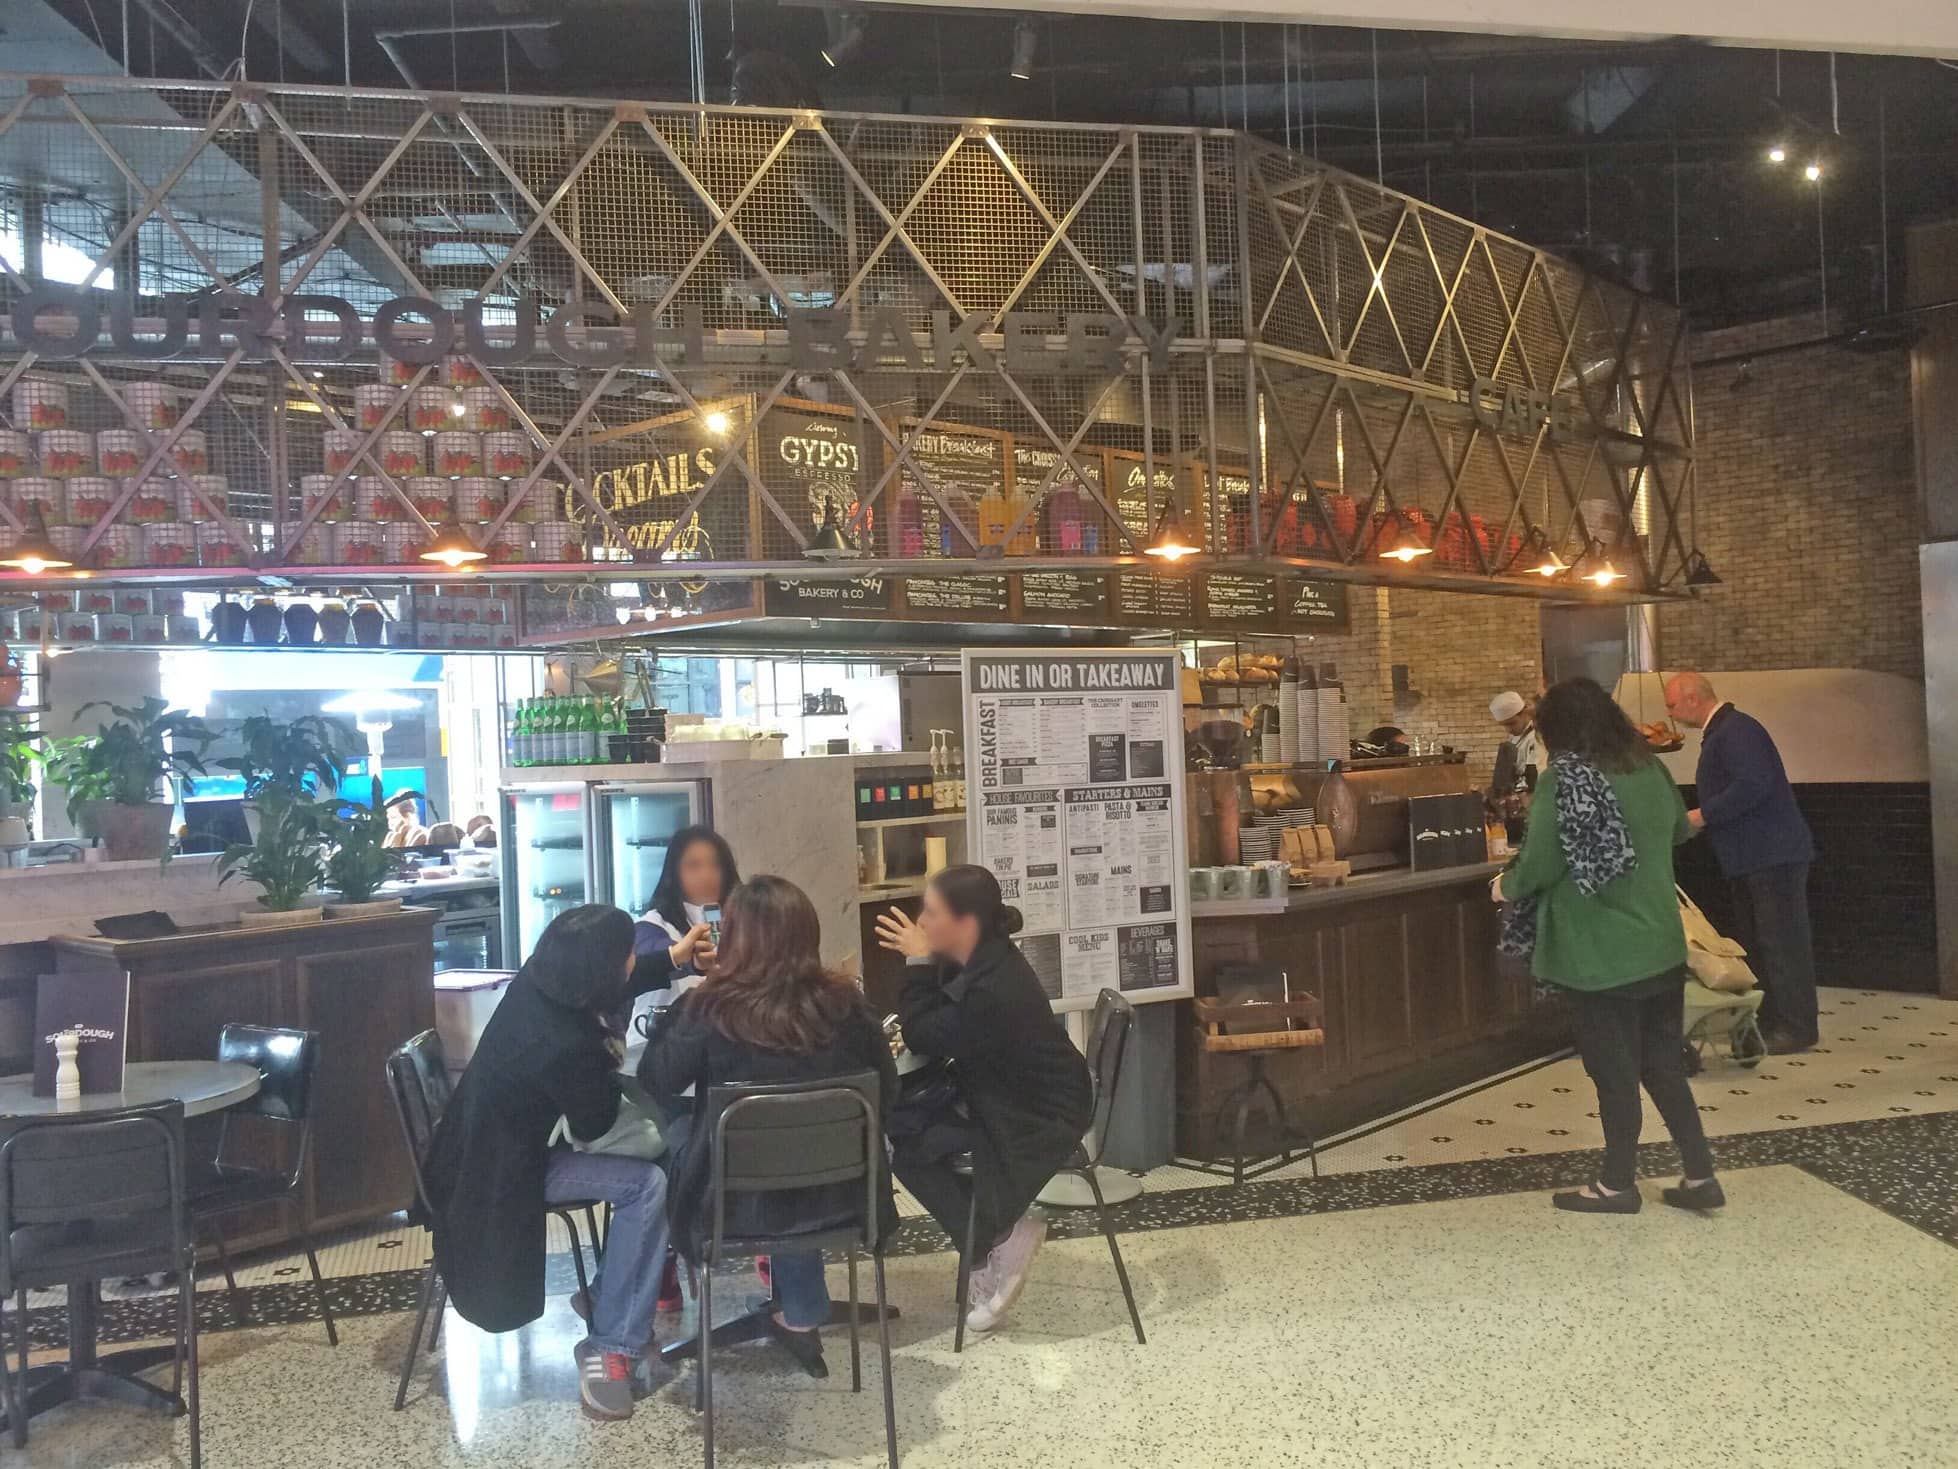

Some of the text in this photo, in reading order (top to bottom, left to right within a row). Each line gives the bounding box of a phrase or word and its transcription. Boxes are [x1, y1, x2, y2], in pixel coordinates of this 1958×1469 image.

[789, 308, 1186, 370] BAKERY
[780, 436, 859, 471] GYPSY
[565, 447, 717, 526] CCKTAILS
[798, 587, 864, 599] BAKERY & CO
[980, 663, 1165, 690] DINE IN OR TAKEAWAY
[979, 699, 998, 788] BREAKFAST
[989, 790, 1053, 804] HOUSE FAVOURITES
[1072, 786, 1164, 801] STARTERS & MAINS
[1069, 803, 1099, 812] ANTIPASTI
[1104, 802, 1124, 811] PASTA
[986, 815, 1018, 826] PANINIS
[1105, 811, 1131, 820] RISOTTO
[1110, 865, 1133, 875] MAINS
[1131, 925, 1165, 938] BEVERAGES
[1068, 934, 1089, 945] COOL
[1078, 943, 1101, 952] MENU
